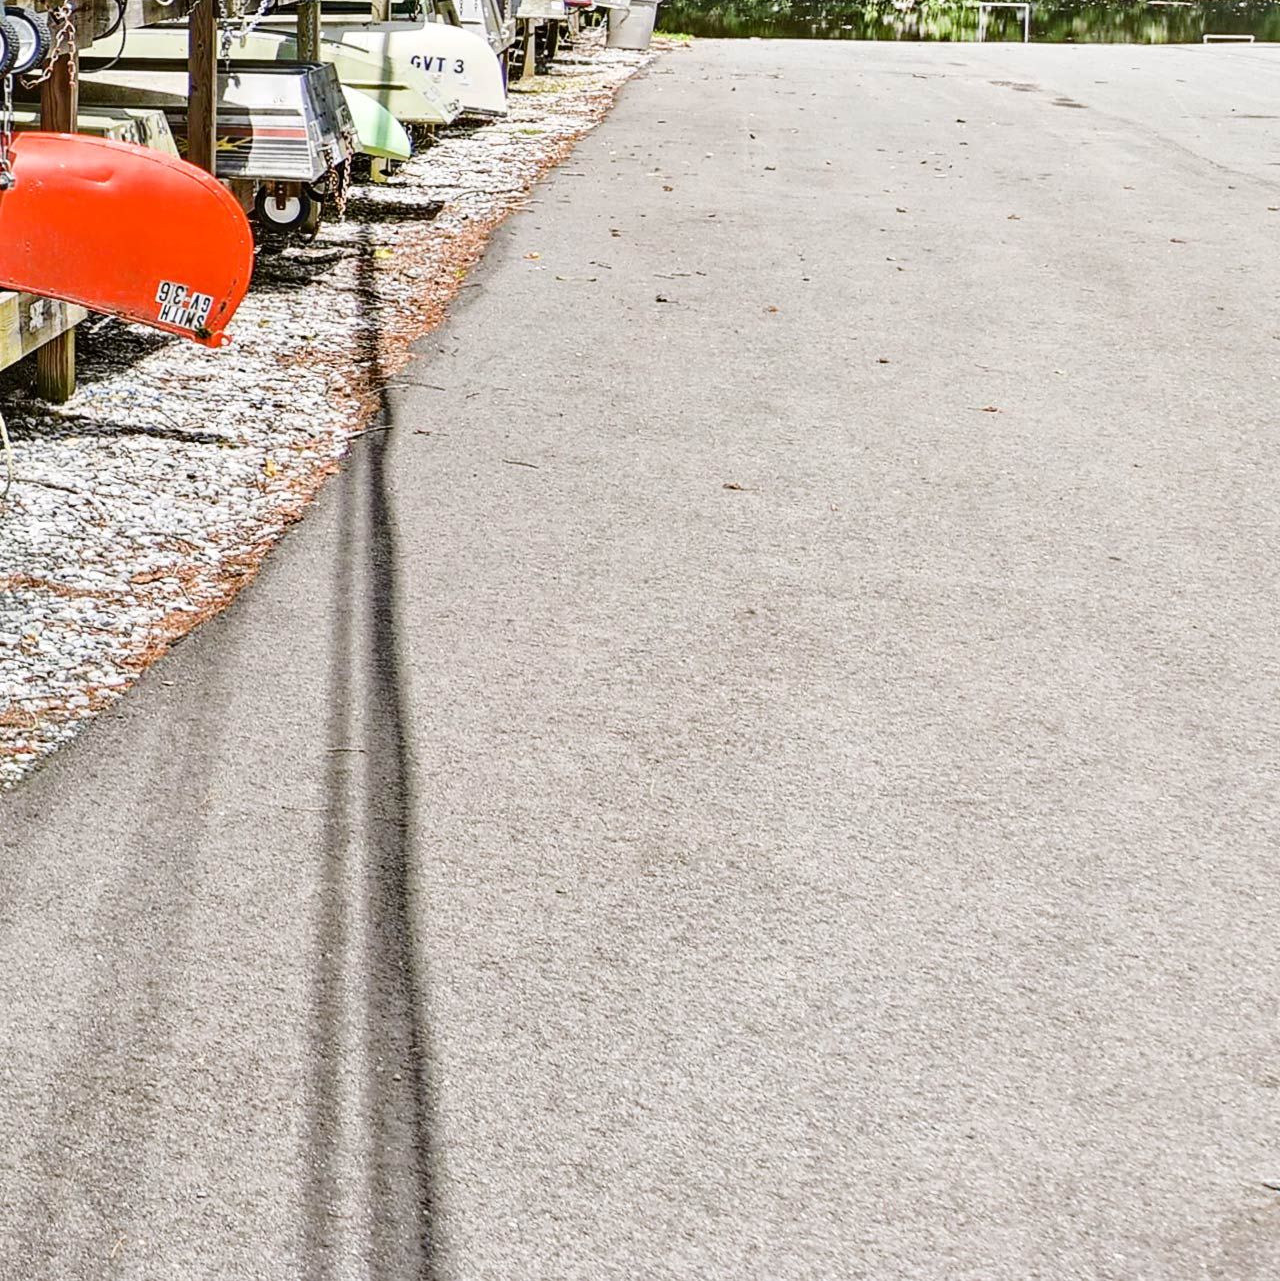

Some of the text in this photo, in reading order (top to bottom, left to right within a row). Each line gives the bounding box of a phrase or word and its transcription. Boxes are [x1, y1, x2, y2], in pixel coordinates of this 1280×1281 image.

[411, 55, 465, 74] GVT 3
[160, 304, 205, 330] SMITH
